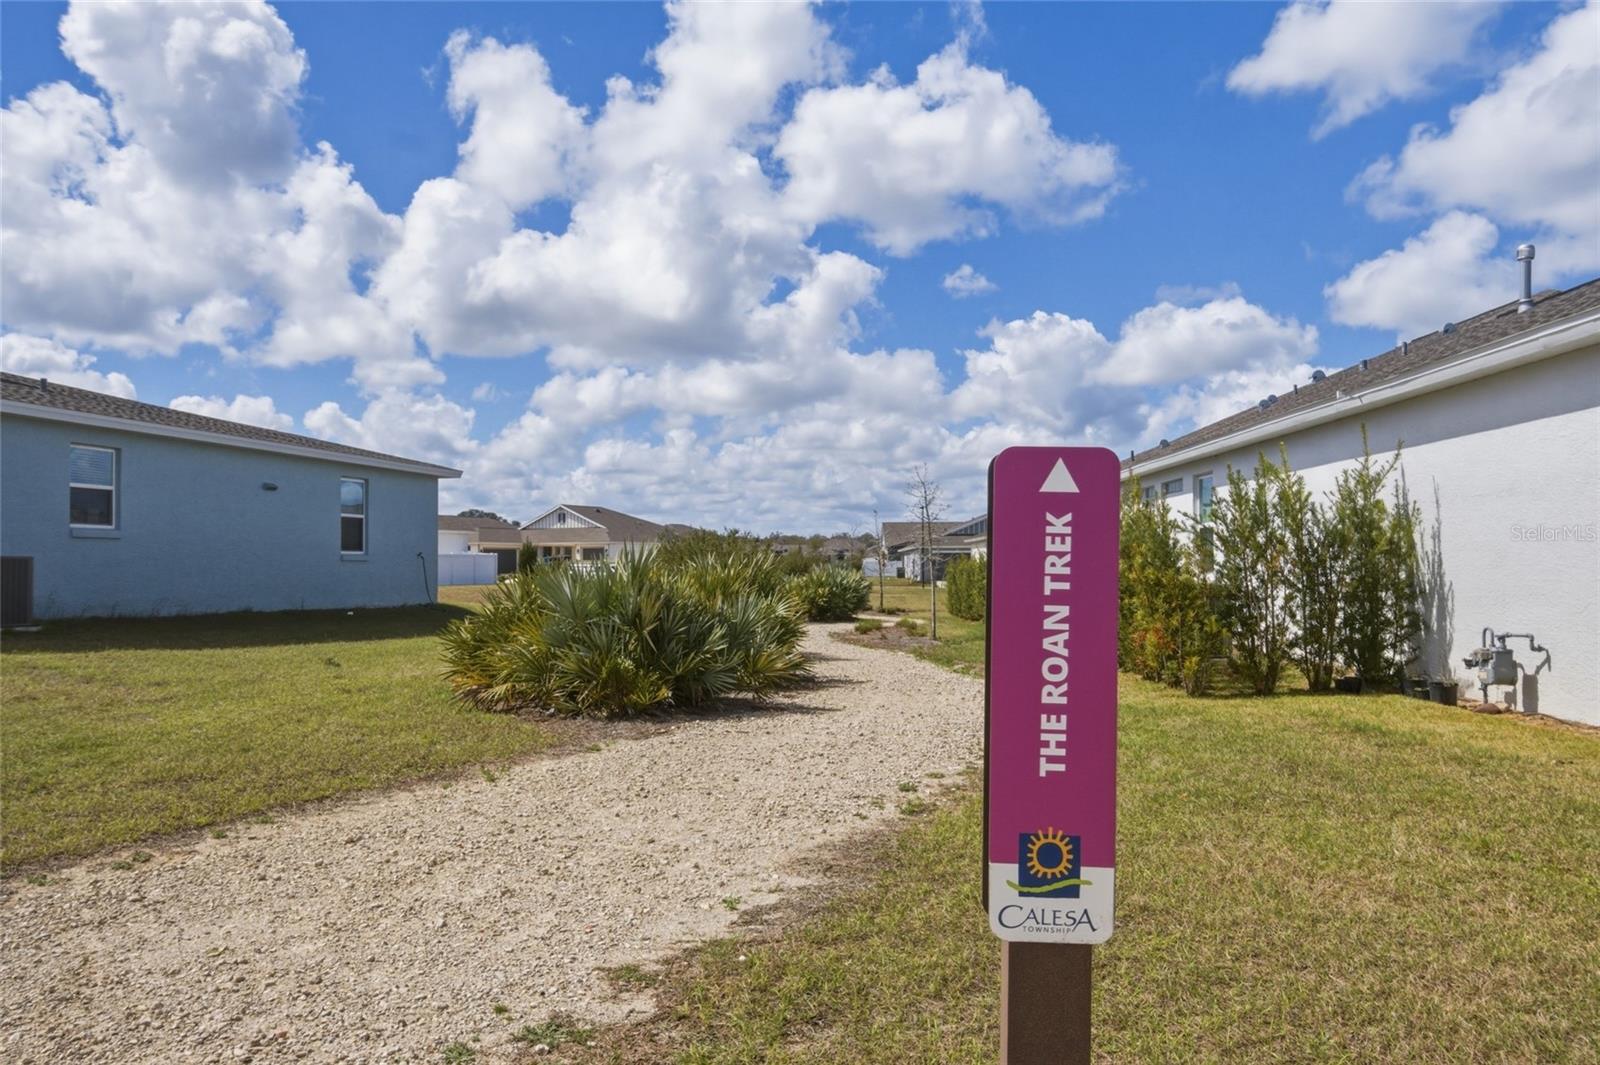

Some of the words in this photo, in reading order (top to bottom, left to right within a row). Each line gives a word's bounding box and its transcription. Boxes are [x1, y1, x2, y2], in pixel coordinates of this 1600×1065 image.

[1043, 511, 1073, 596] TREK
[1041, 604, 1070, 705] ROAN
[1039, 714, 1067, 777] THE
[998, 904, 1097, 932] CALESA
[1023, 925, 1072, 934] TOWNSHIP
